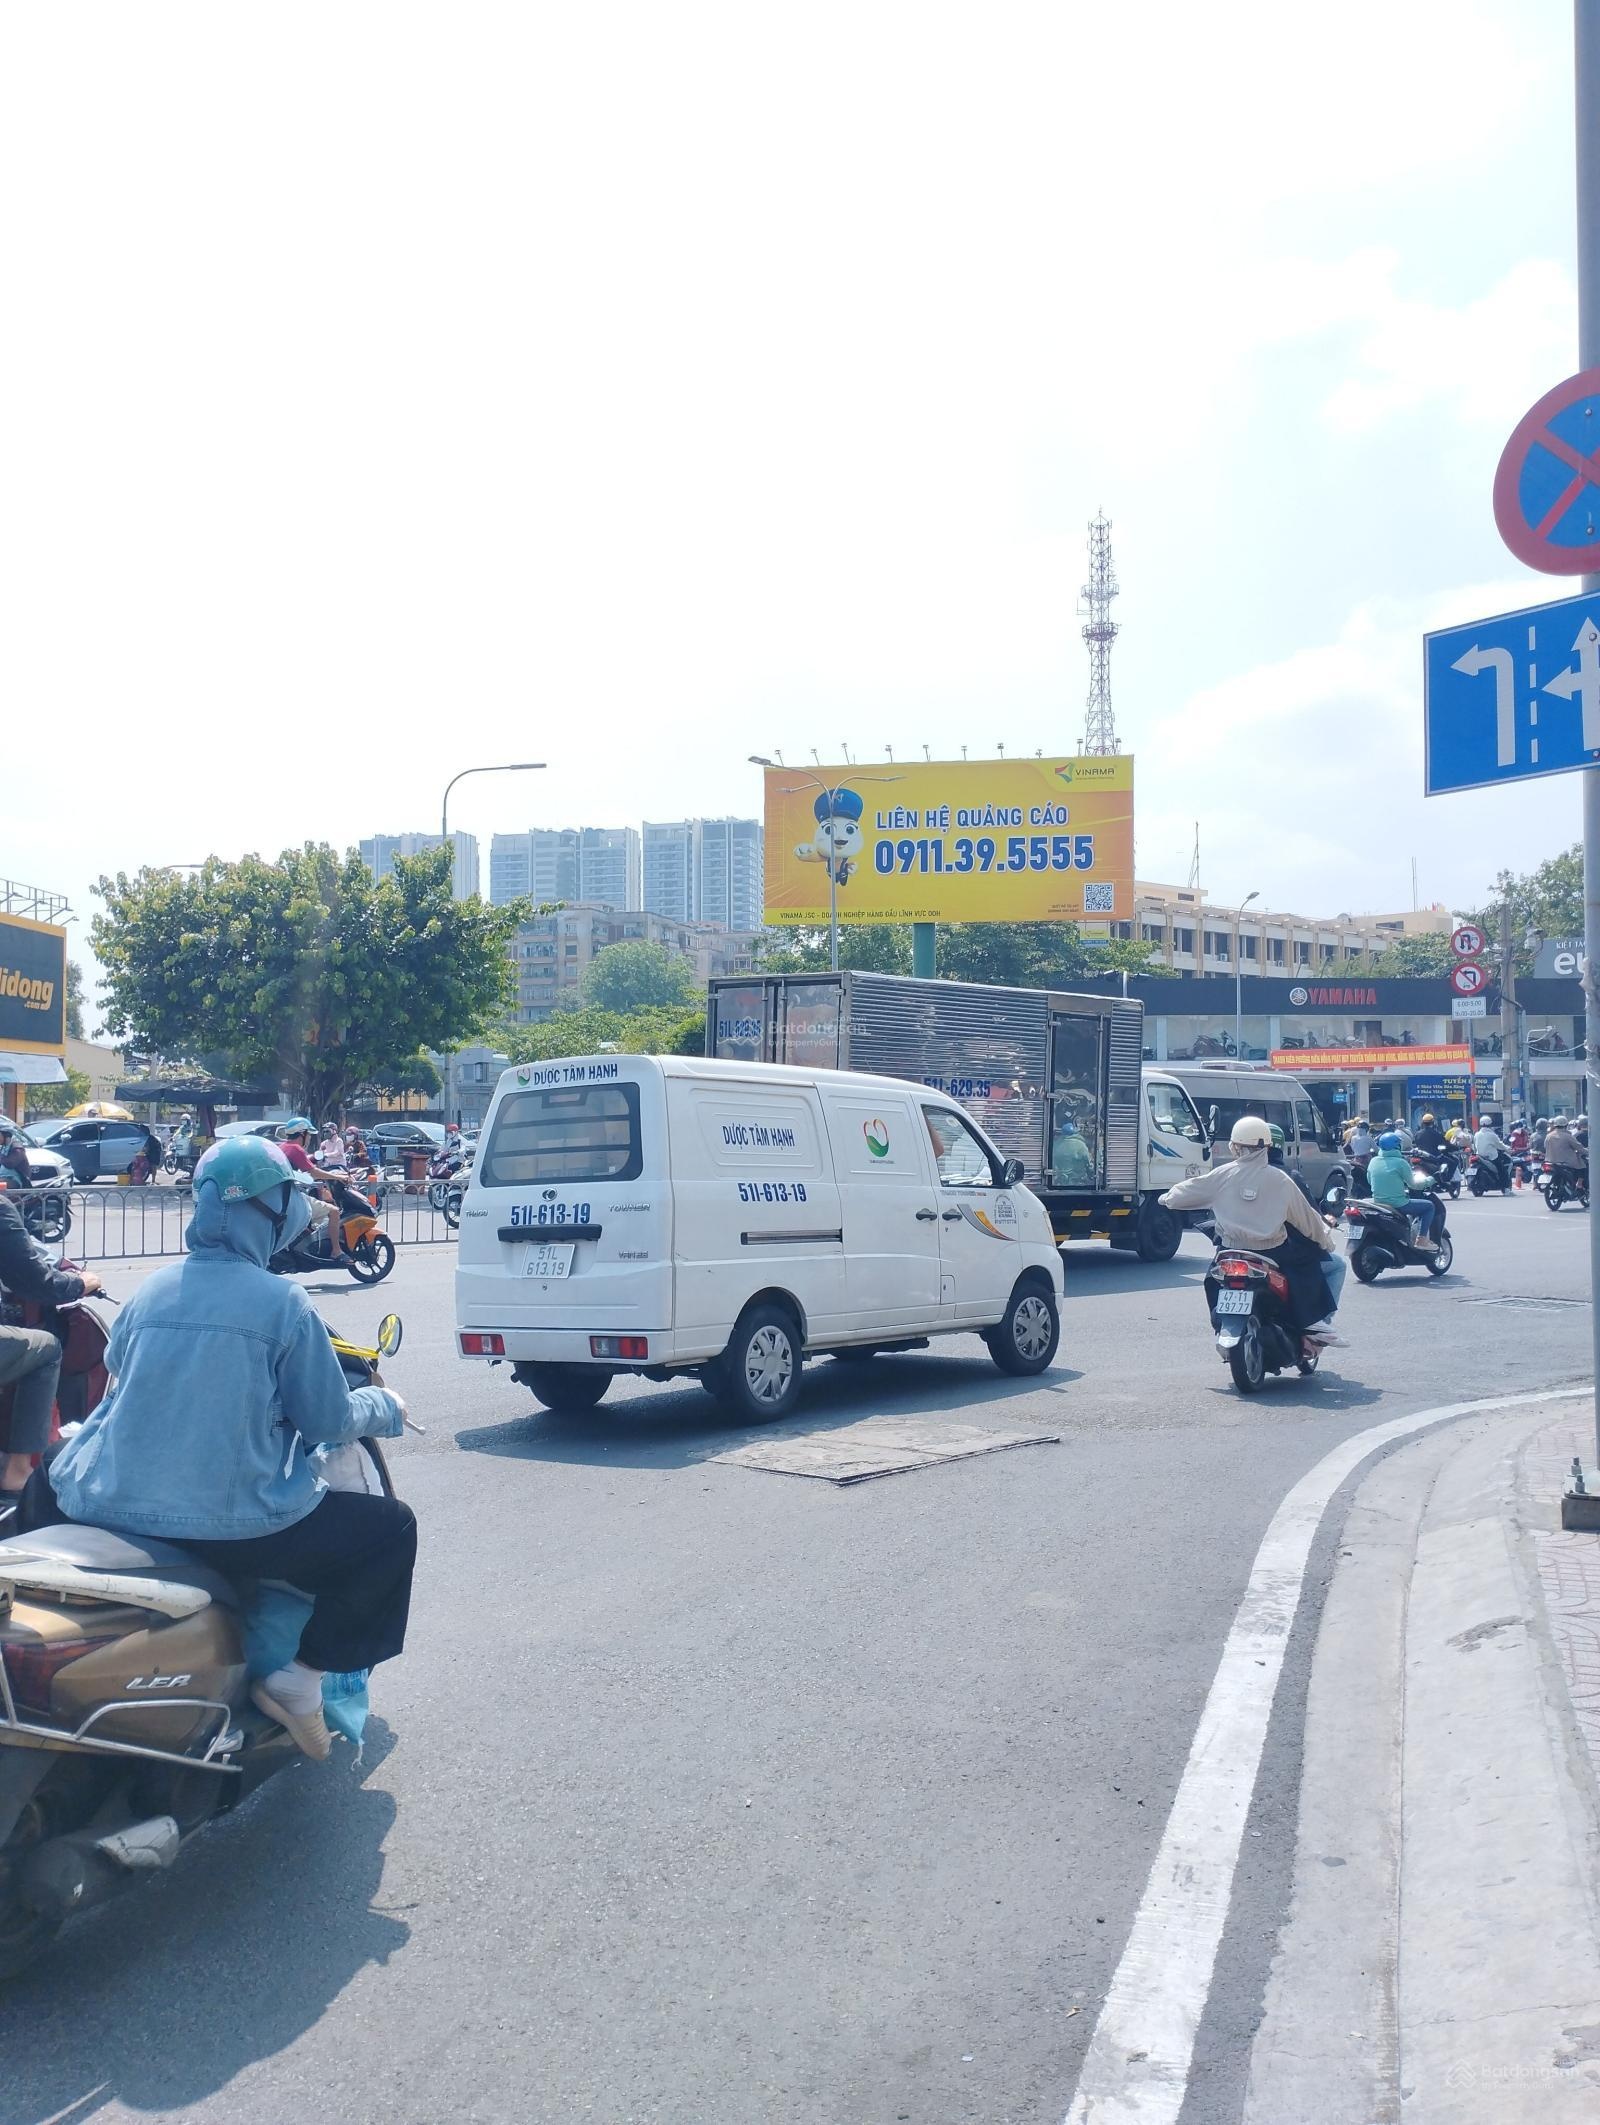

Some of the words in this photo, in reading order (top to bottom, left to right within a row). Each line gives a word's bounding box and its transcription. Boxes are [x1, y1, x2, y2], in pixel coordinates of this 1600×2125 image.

[1075, 767, 1115, 776] VINAMA
[876, 806, 918, 829] LIÊN
[926, 804, 950, 833] HỆ
[957, 803, 1023, 827] QUẢNG
[1029, 801, 1068, 825] CÁO
[874, 835, 1094, 874] 0911.39.5555
[1308, 988, 1377, 1005] YAMAHA
[534, 1068, 561, 1087] DƯỢC
[563, 1065, 585, 1082] TÂM
[588, 1063, 618, 1082] HẠNH
[722, 1123, 748, 1150] DƯỢC
[749, 1123, 770, 1146] TÂM
[772, 1128, 795, 1151] HẠNH
[538, 1247, 557, 1260] 51L
[526, 1262, 565, 1276] 613.19
